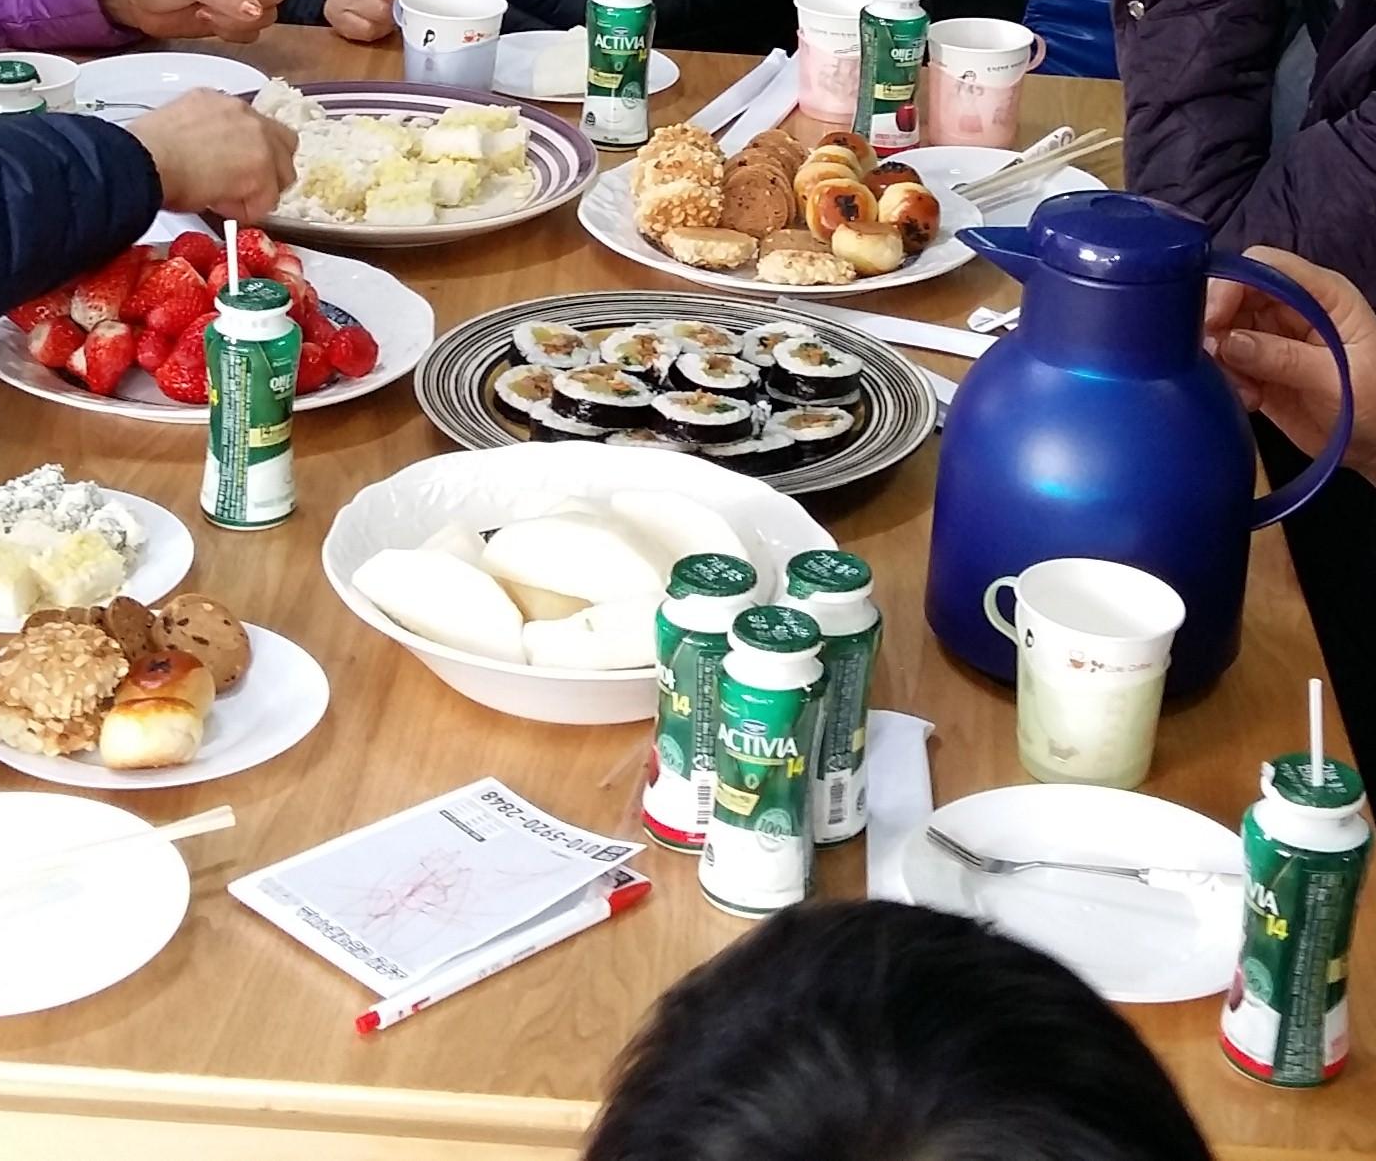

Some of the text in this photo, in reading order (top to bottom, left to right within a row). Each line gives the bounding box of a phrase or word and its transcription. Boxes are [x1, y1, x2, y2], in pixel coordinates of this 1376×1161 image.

[594, 33, 645, 50] ACTIVIA
[671, 691, 692, 716] 14
[718, 722, 799, 758] ACTIVIA
[786, 755, 805, 778] 14
[1265, 914, 1289, 941] 14
